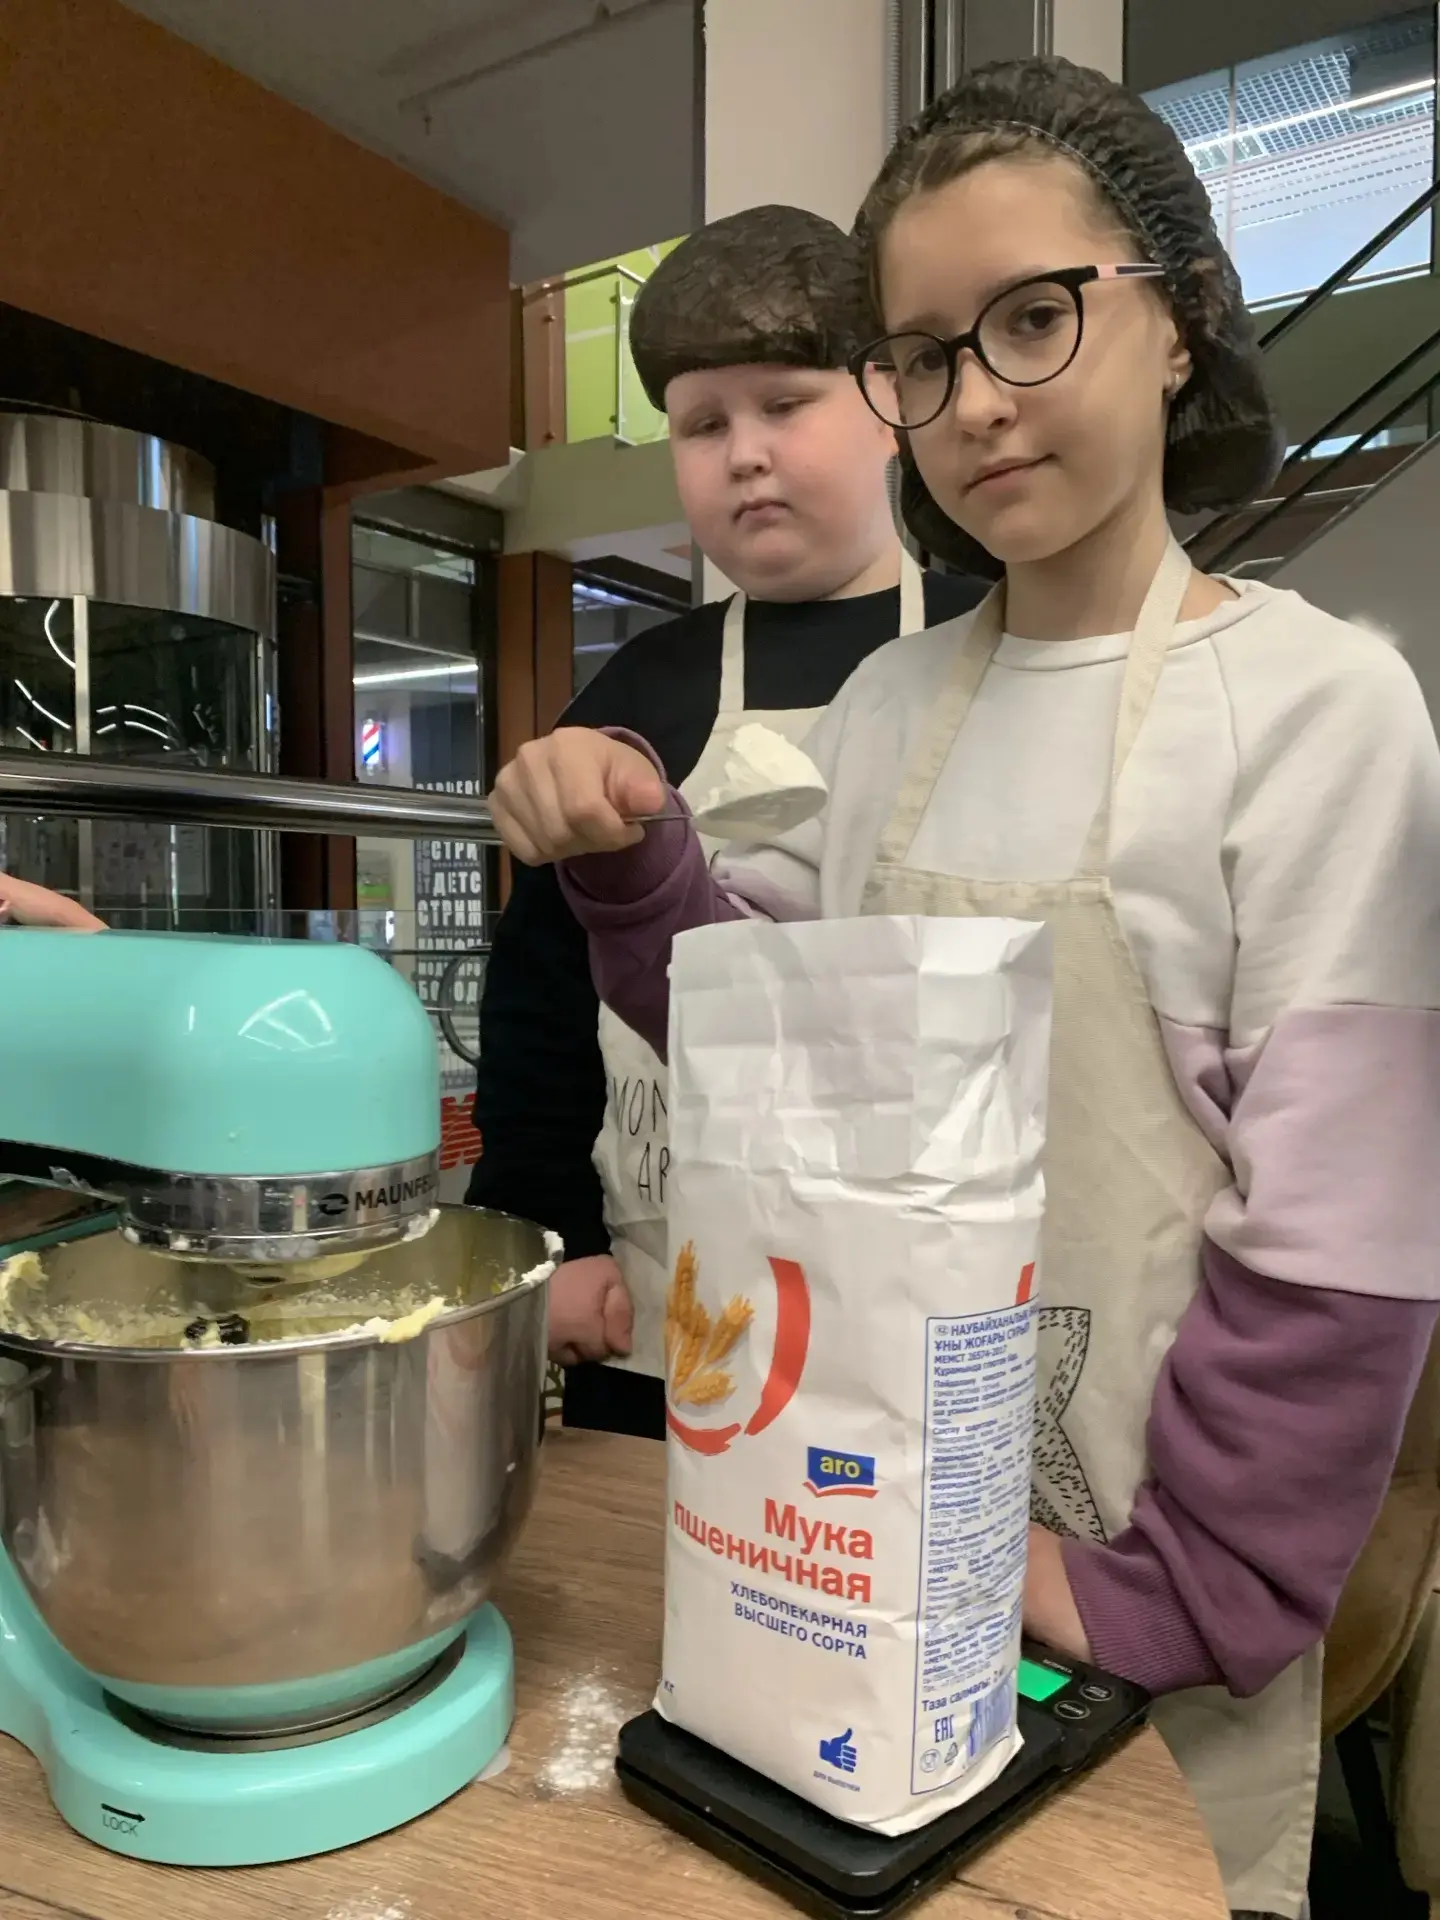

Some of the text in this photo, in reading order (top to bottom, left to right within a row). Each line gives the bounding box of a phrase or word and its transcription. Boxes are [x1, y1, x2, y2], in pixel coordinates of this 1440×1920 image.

[432, 871, 481, 897] ДЕТС
[418, 980, 479, 1004] БООД
[820, 1455, 861, 1478] aro
[764, 1497, 875, 1561] Мука
[673, 1499, 872, 1604] пшеничная
[730, 1580, 868, 1639] ХЛЕБОПЕКАРНАЯ
[733, 1601, 867, 1660] ВЫСШЕГО СОРТА
[921, 1697, 948, 1712] Таза
[102, 1813, 139, 1837] LOCK
